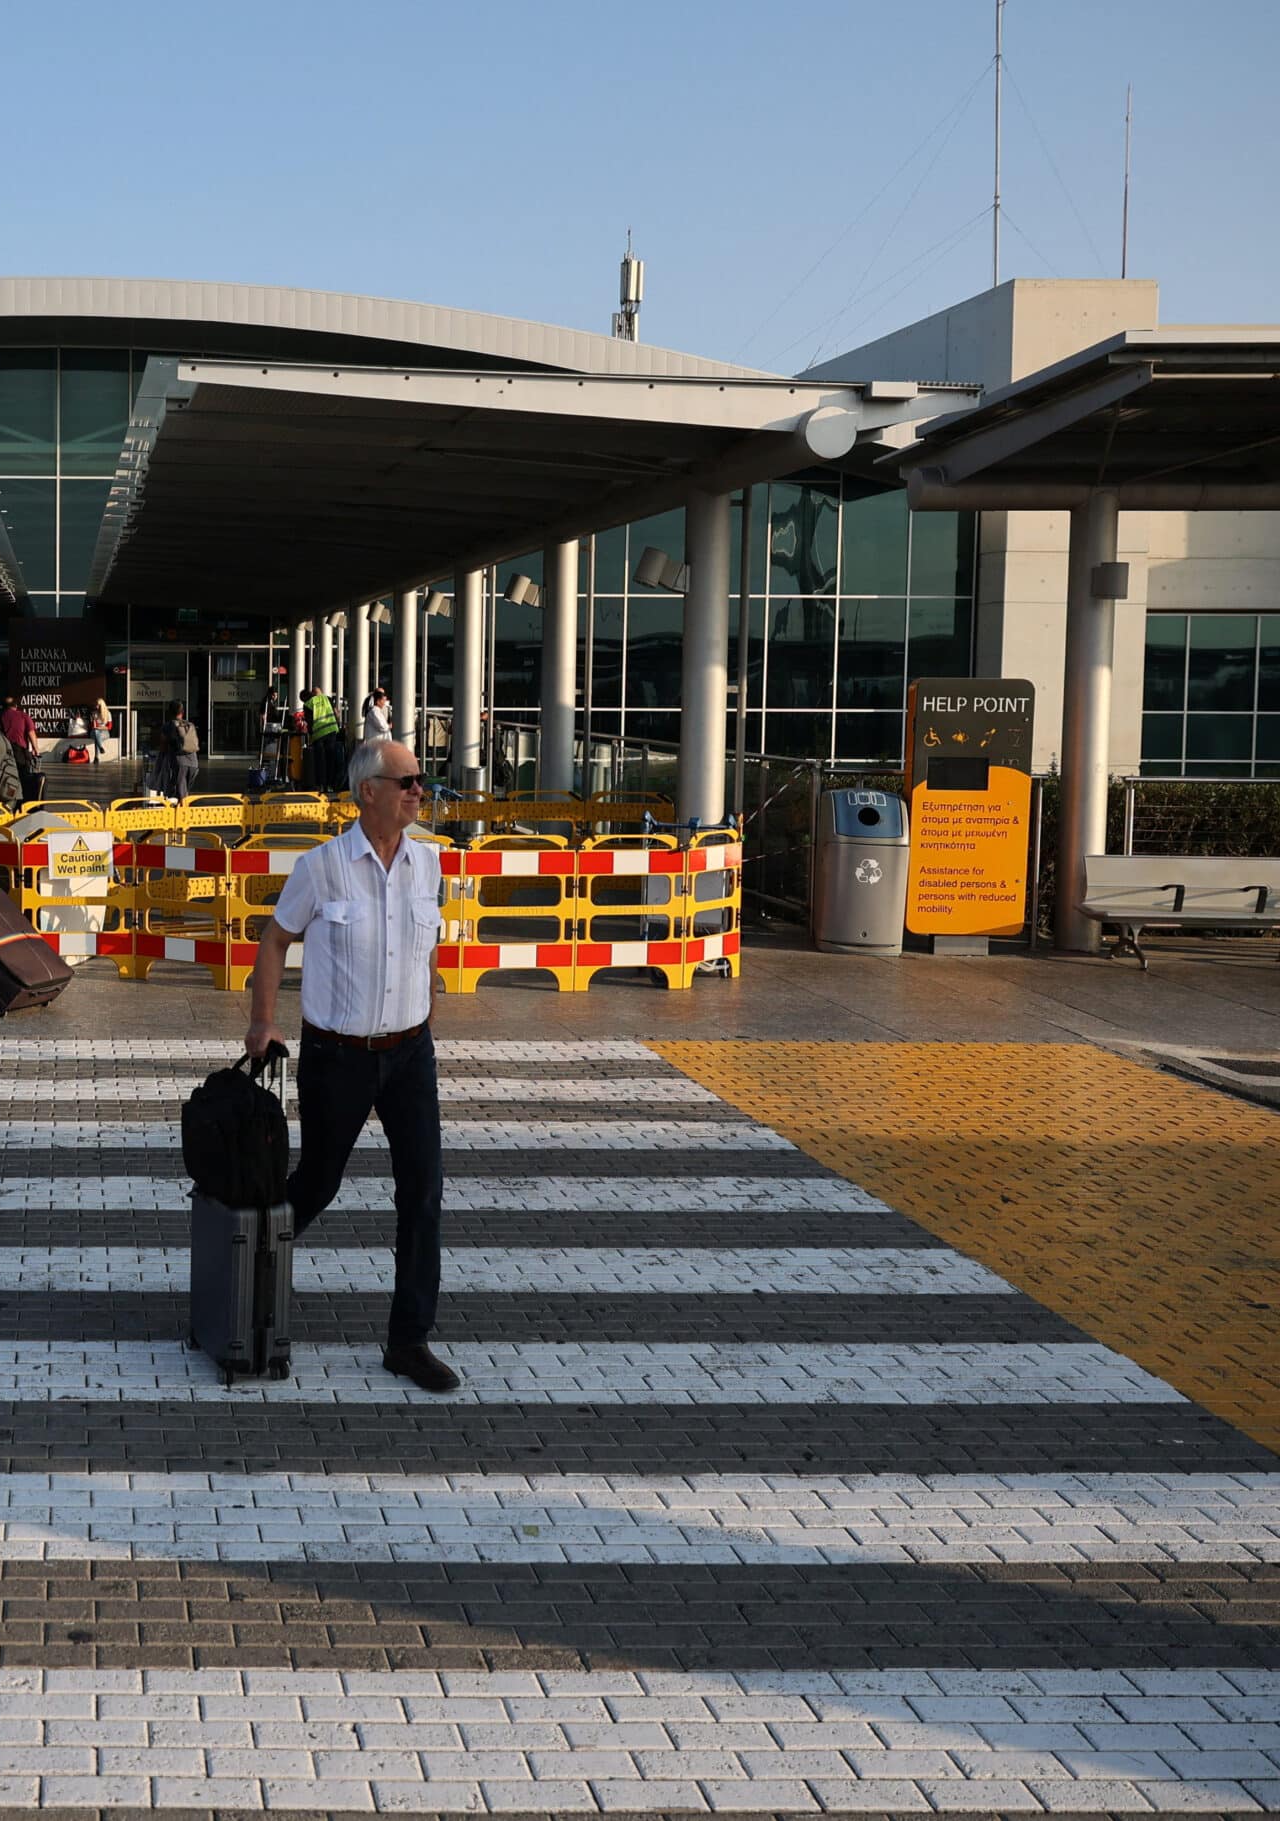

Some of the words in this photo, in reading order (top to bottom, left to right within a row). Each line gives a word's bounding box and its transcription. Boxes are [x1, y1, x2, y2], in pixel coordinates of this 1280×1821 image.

[21, 648, 66, 659] LARNAKA
[21, 662, 94, 672] INTERNATIONAL
[21, 676, 60, 686] AIRPORT
[21, 694, 62, 705] ΔΙΕΘΝΗΣ
[923, 696, 967, 713] HELP
[973, 697, 1030, 713] POINT
[922, 802, 985, 812] Εξυπηρέτηση
[988, 804, 1001, 812] για
[921, 815, 950, 824] άτομα
[965, 816, 1010, 826] αναπηρία
[1012, 816, 1020, 825] &
[920, 827, 949, 837] άτομα
[952, 830, 963, 838] με
[60, 853, 102, 863] Caution
[57, 864, 77, 874] Wet
[80, 864, 106, 876] paint
[919, 866, 970, 875] Assistance
[972, 866, 985, 876] for
[918, 879, 958, 888] disabled
[999, 880, 1007, 889] &
[918, 893, 955, 901] persons
[958, 893, 977, 901] with
[979, 893, 1017, 902] reduced
[917, 905, 953, 915] mobility
